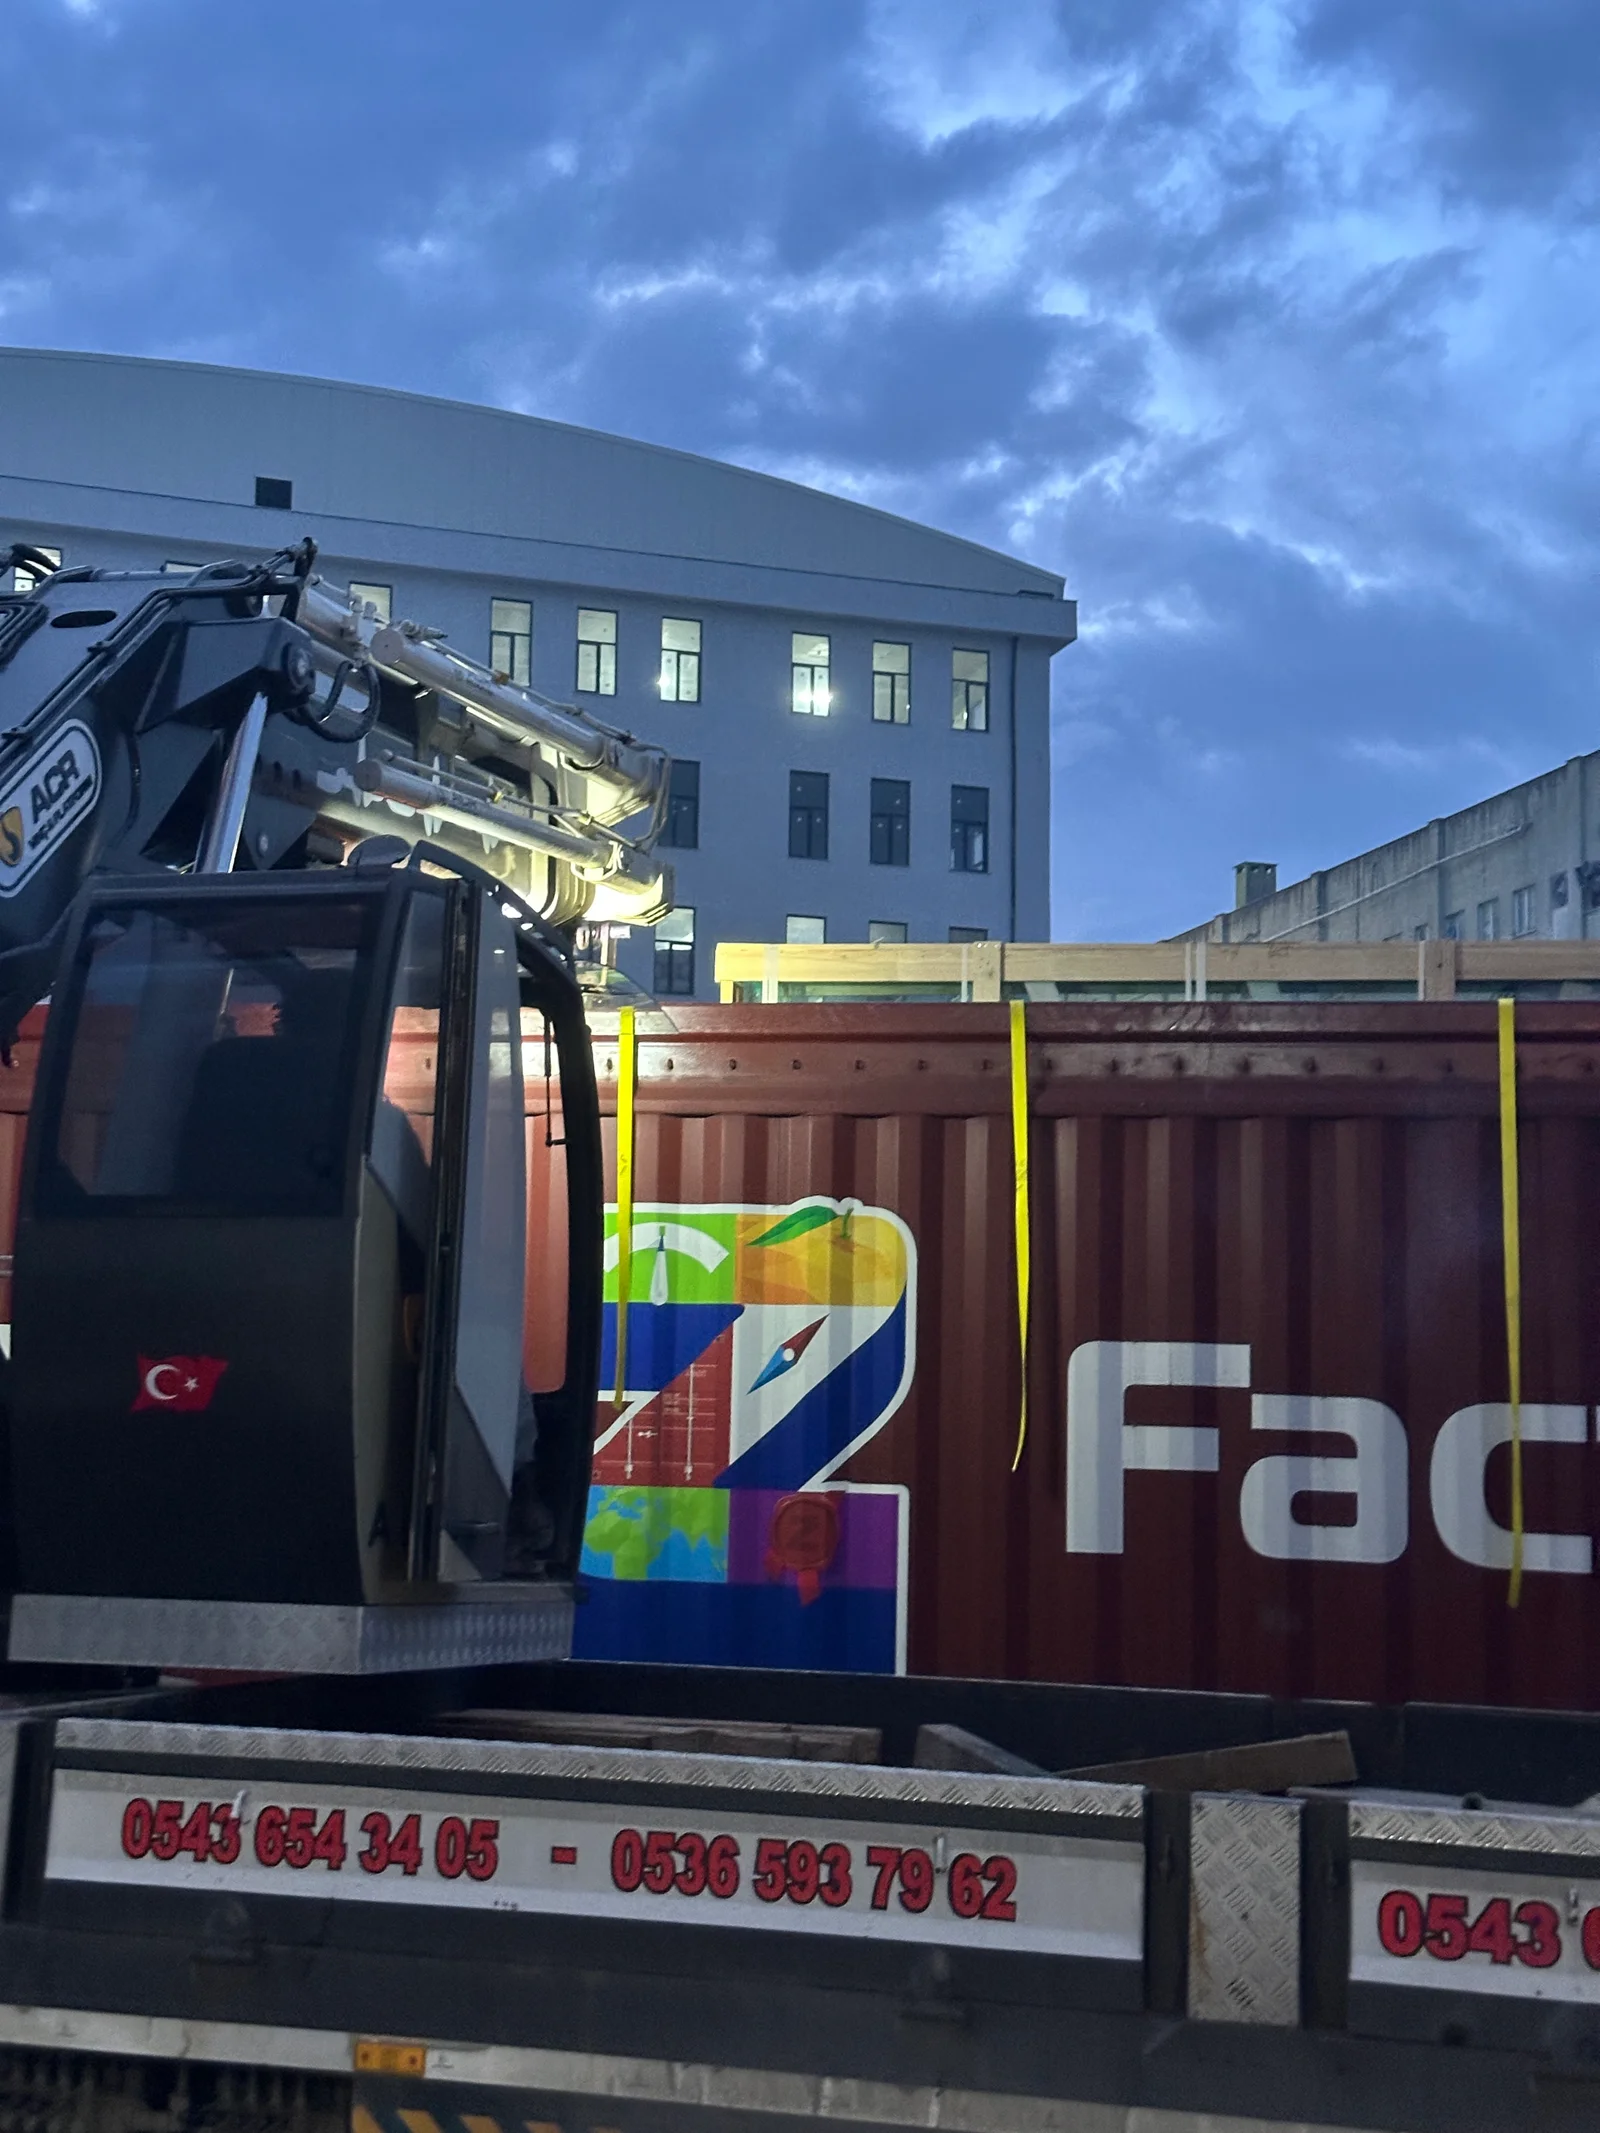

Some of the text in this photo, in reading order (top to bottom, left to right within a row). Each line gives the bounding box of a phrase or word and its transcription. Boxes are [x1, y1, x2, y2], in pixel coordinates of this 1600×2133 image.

[30, 749, 80, 824] ACR
[1066, 1340, 1600, 1575] Fac
[121, 1797, 243, 1865] 0543
[253, 1805, 347, 1870] 654
[359, 1812, 423, 1875] 34
[435, 1816, 499, 1881] 05
[610, 1828, 740, 1898] 0536
[752, 1838, 853, 1907] 593
[866, 1846, 934, 1913] 79
[948, 1853, 1018, 1921] 62
[1378, 1890, 1561, 1968] 0543
